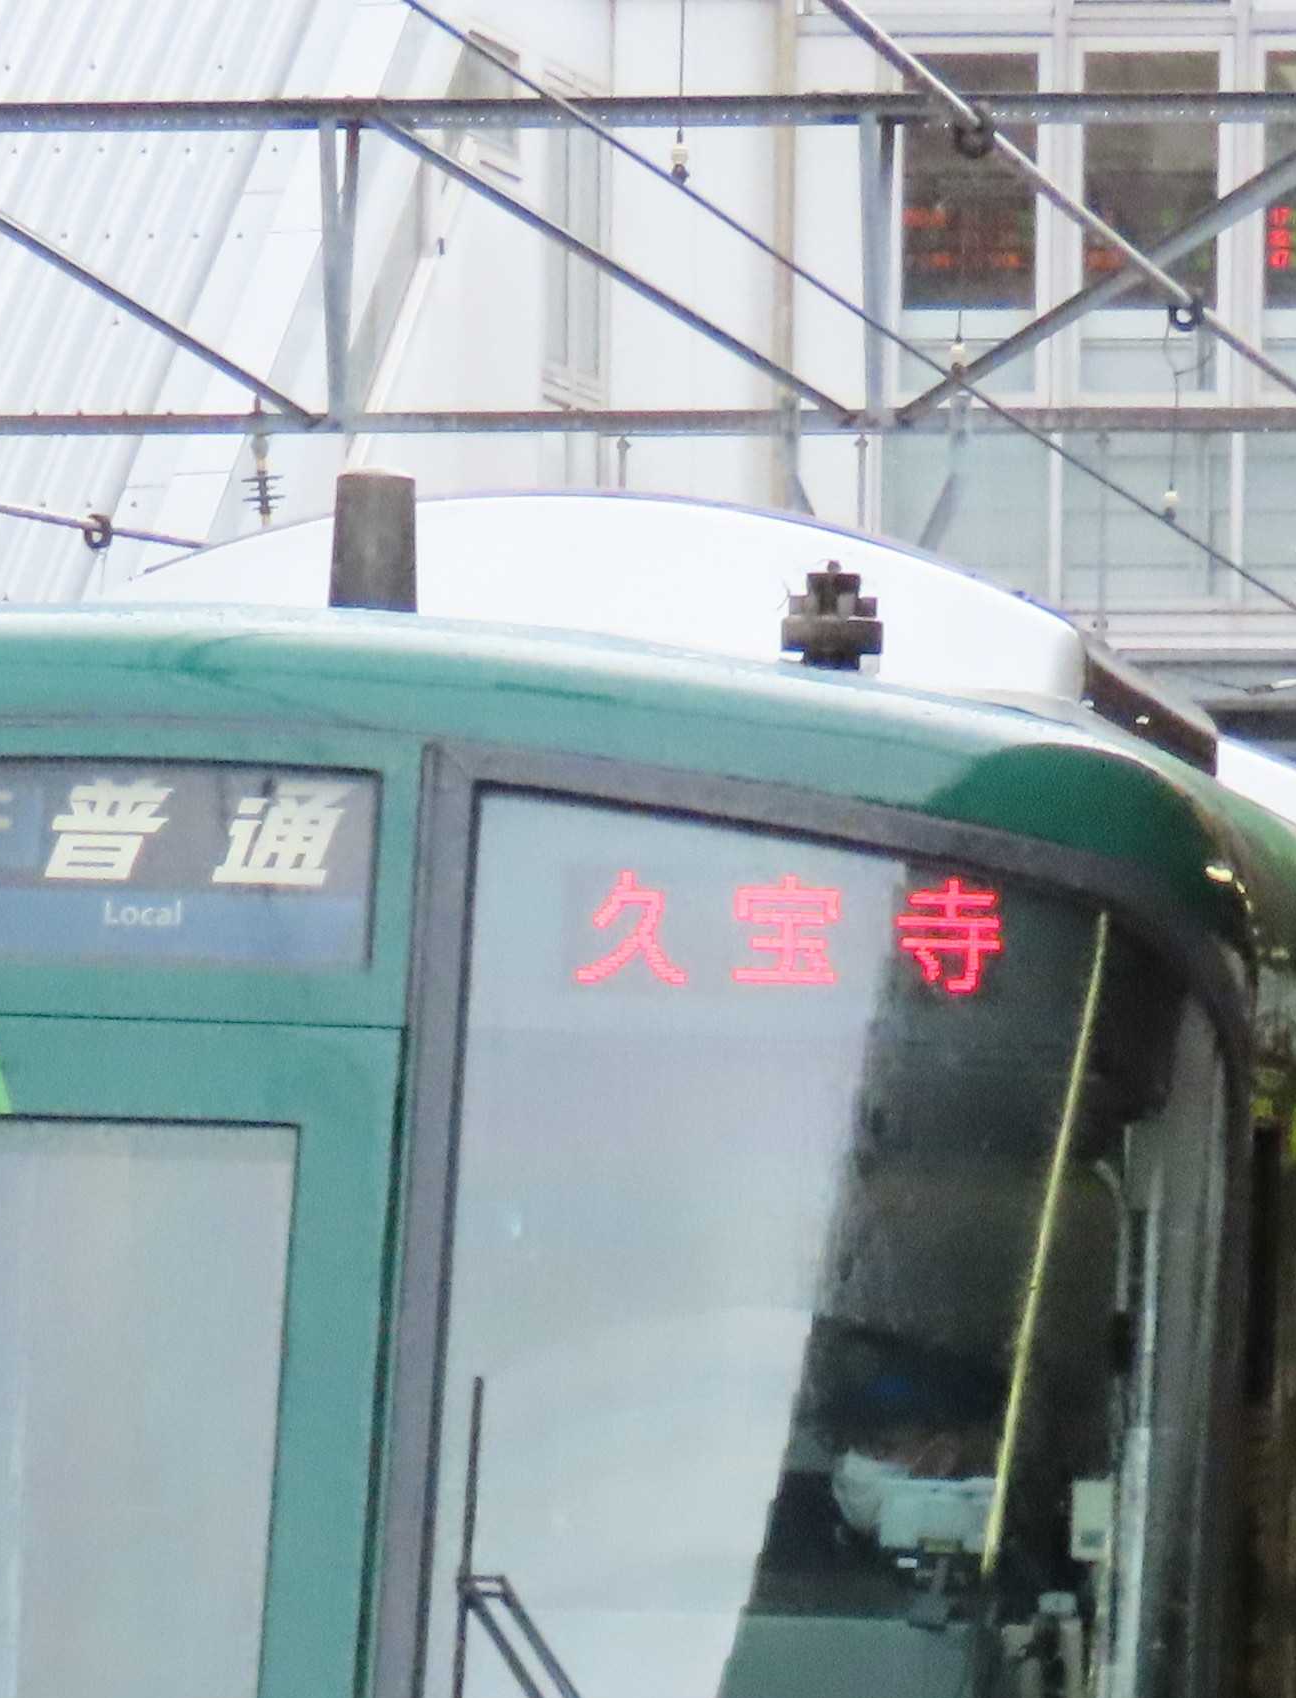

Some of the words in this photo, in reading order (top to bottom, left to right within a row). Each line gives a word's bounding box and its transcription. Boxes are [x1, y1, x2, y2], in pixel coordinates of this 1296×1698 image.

[43, 778, 361, 886] 普通
[104, 900, 182, 927] Local
[576, 869, 1003, 996] 久宝寺
